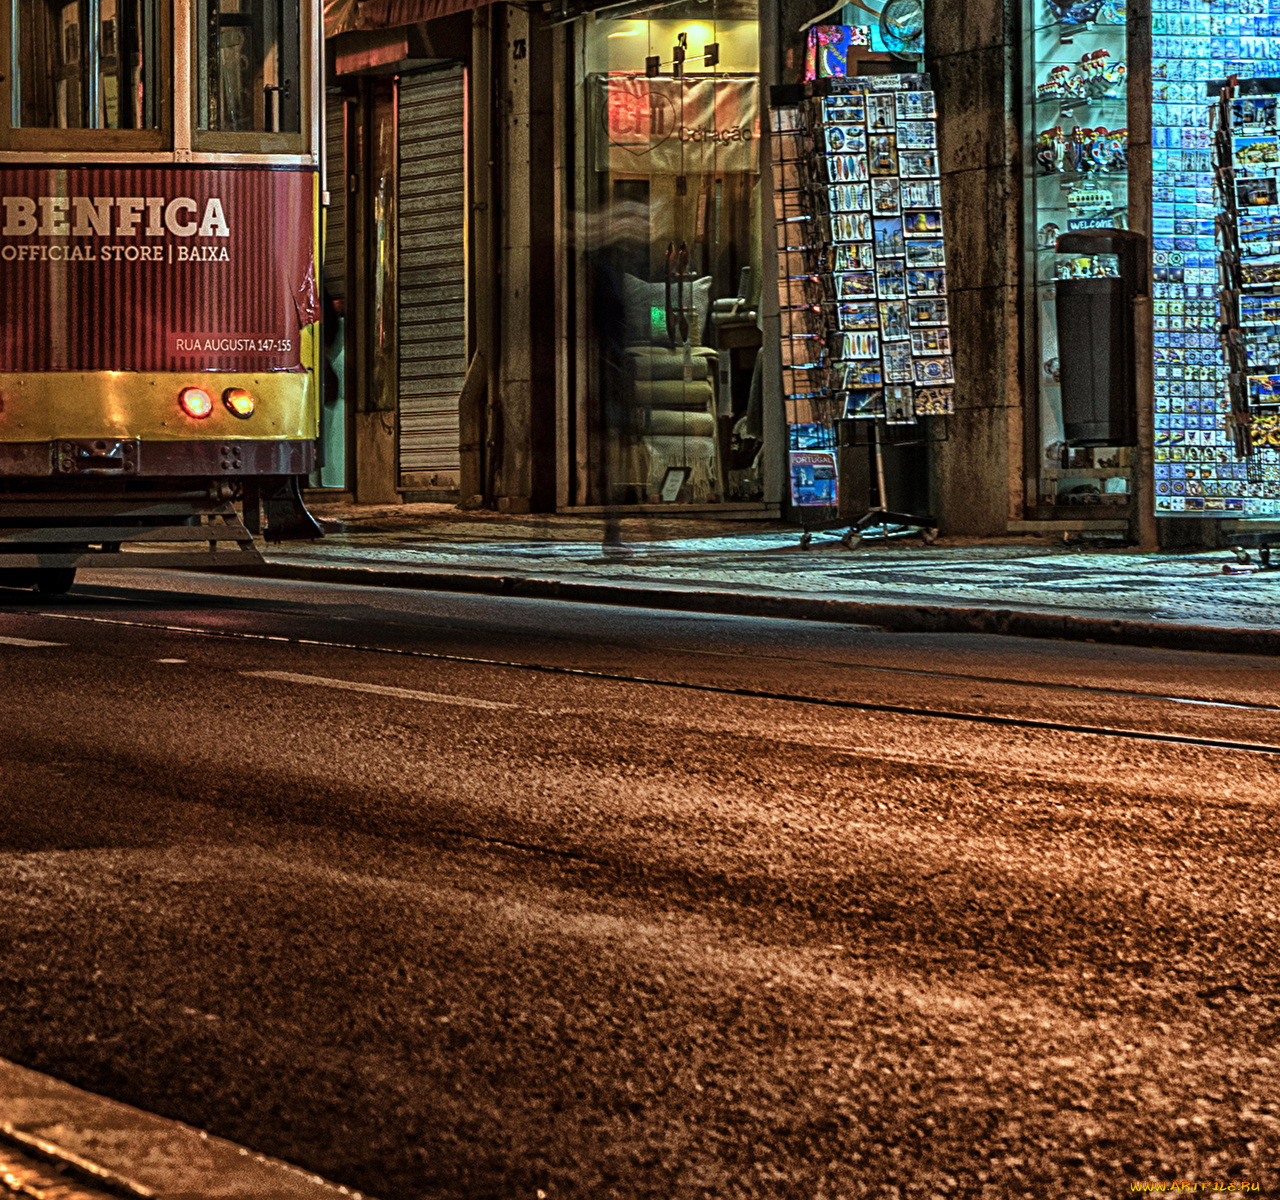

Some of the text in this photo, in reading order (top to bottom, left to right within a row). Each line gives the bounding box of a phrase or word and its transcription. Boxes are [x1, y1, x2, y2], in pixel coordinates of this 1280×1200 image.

[2, 197, 230, 238] BENFICA
[1, 246, 230, 262] OFFICIAL STORE BAIXA
[176, 338, 292, 352] RUA AUGUSTA 147-155
